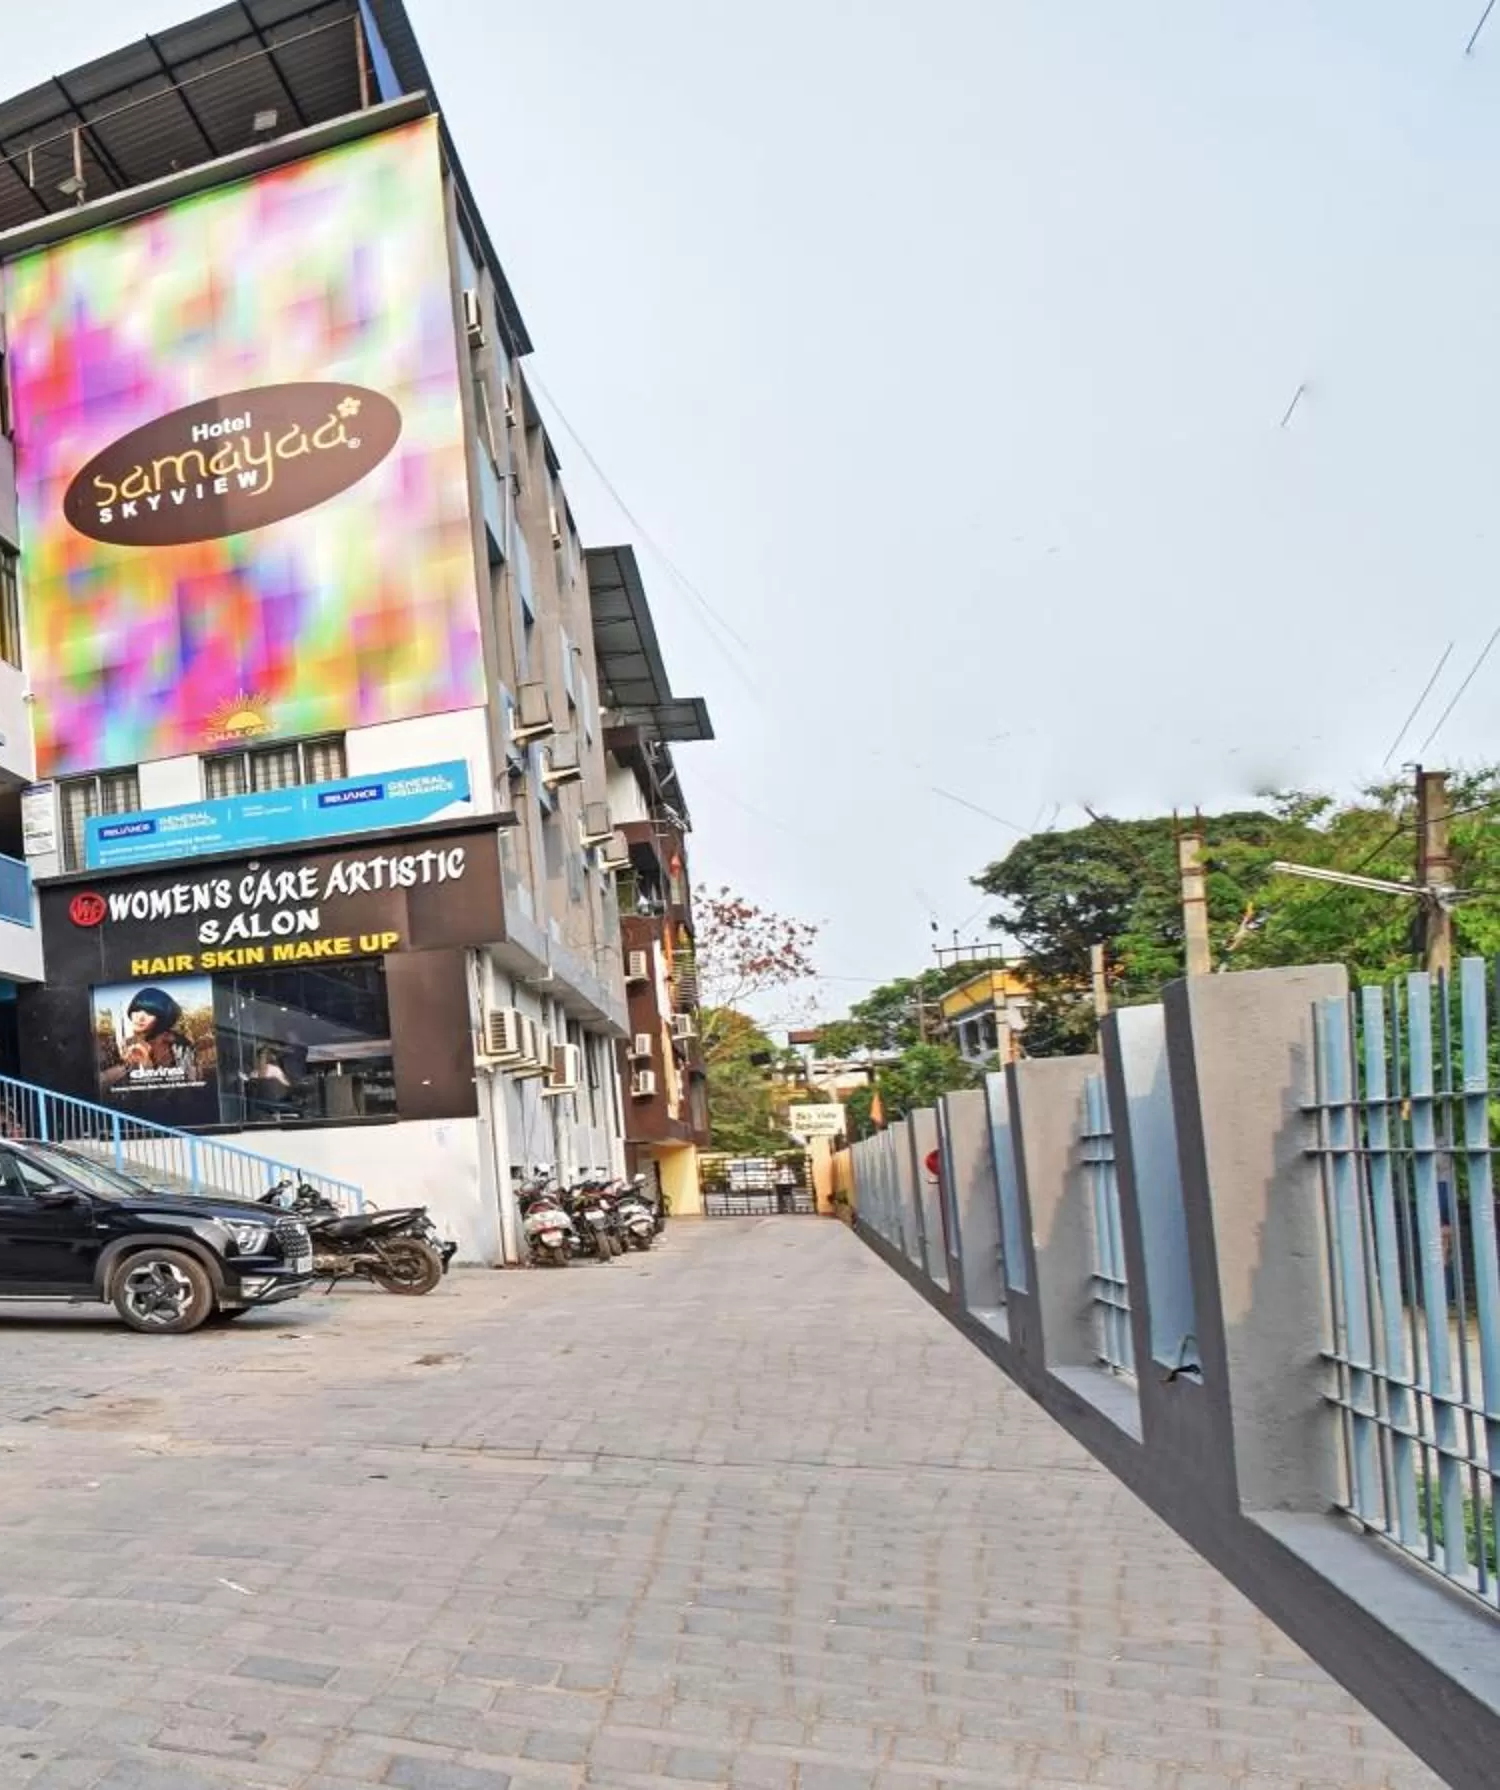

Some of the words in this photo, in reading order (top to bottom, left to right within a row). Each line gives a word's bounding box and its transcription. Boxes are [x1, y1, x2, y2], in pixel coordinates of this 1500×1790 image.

[192, 412, 251, 443] Hotel
[99, 470, 260, 524] SKYVIEW
[108, 878, 231, 922] WOMEN'S
[239, 865, 319, 912] CARE
[323, 847, 466, 901] ARTISTIC
[199, 907, 320, 945] SALON
[131, 954, 193, 977] HAIR
[200, 946, 264, 970] SKIN
[274, 937, 352, 960] MAKE
[360, 931, 400, 954] UP
